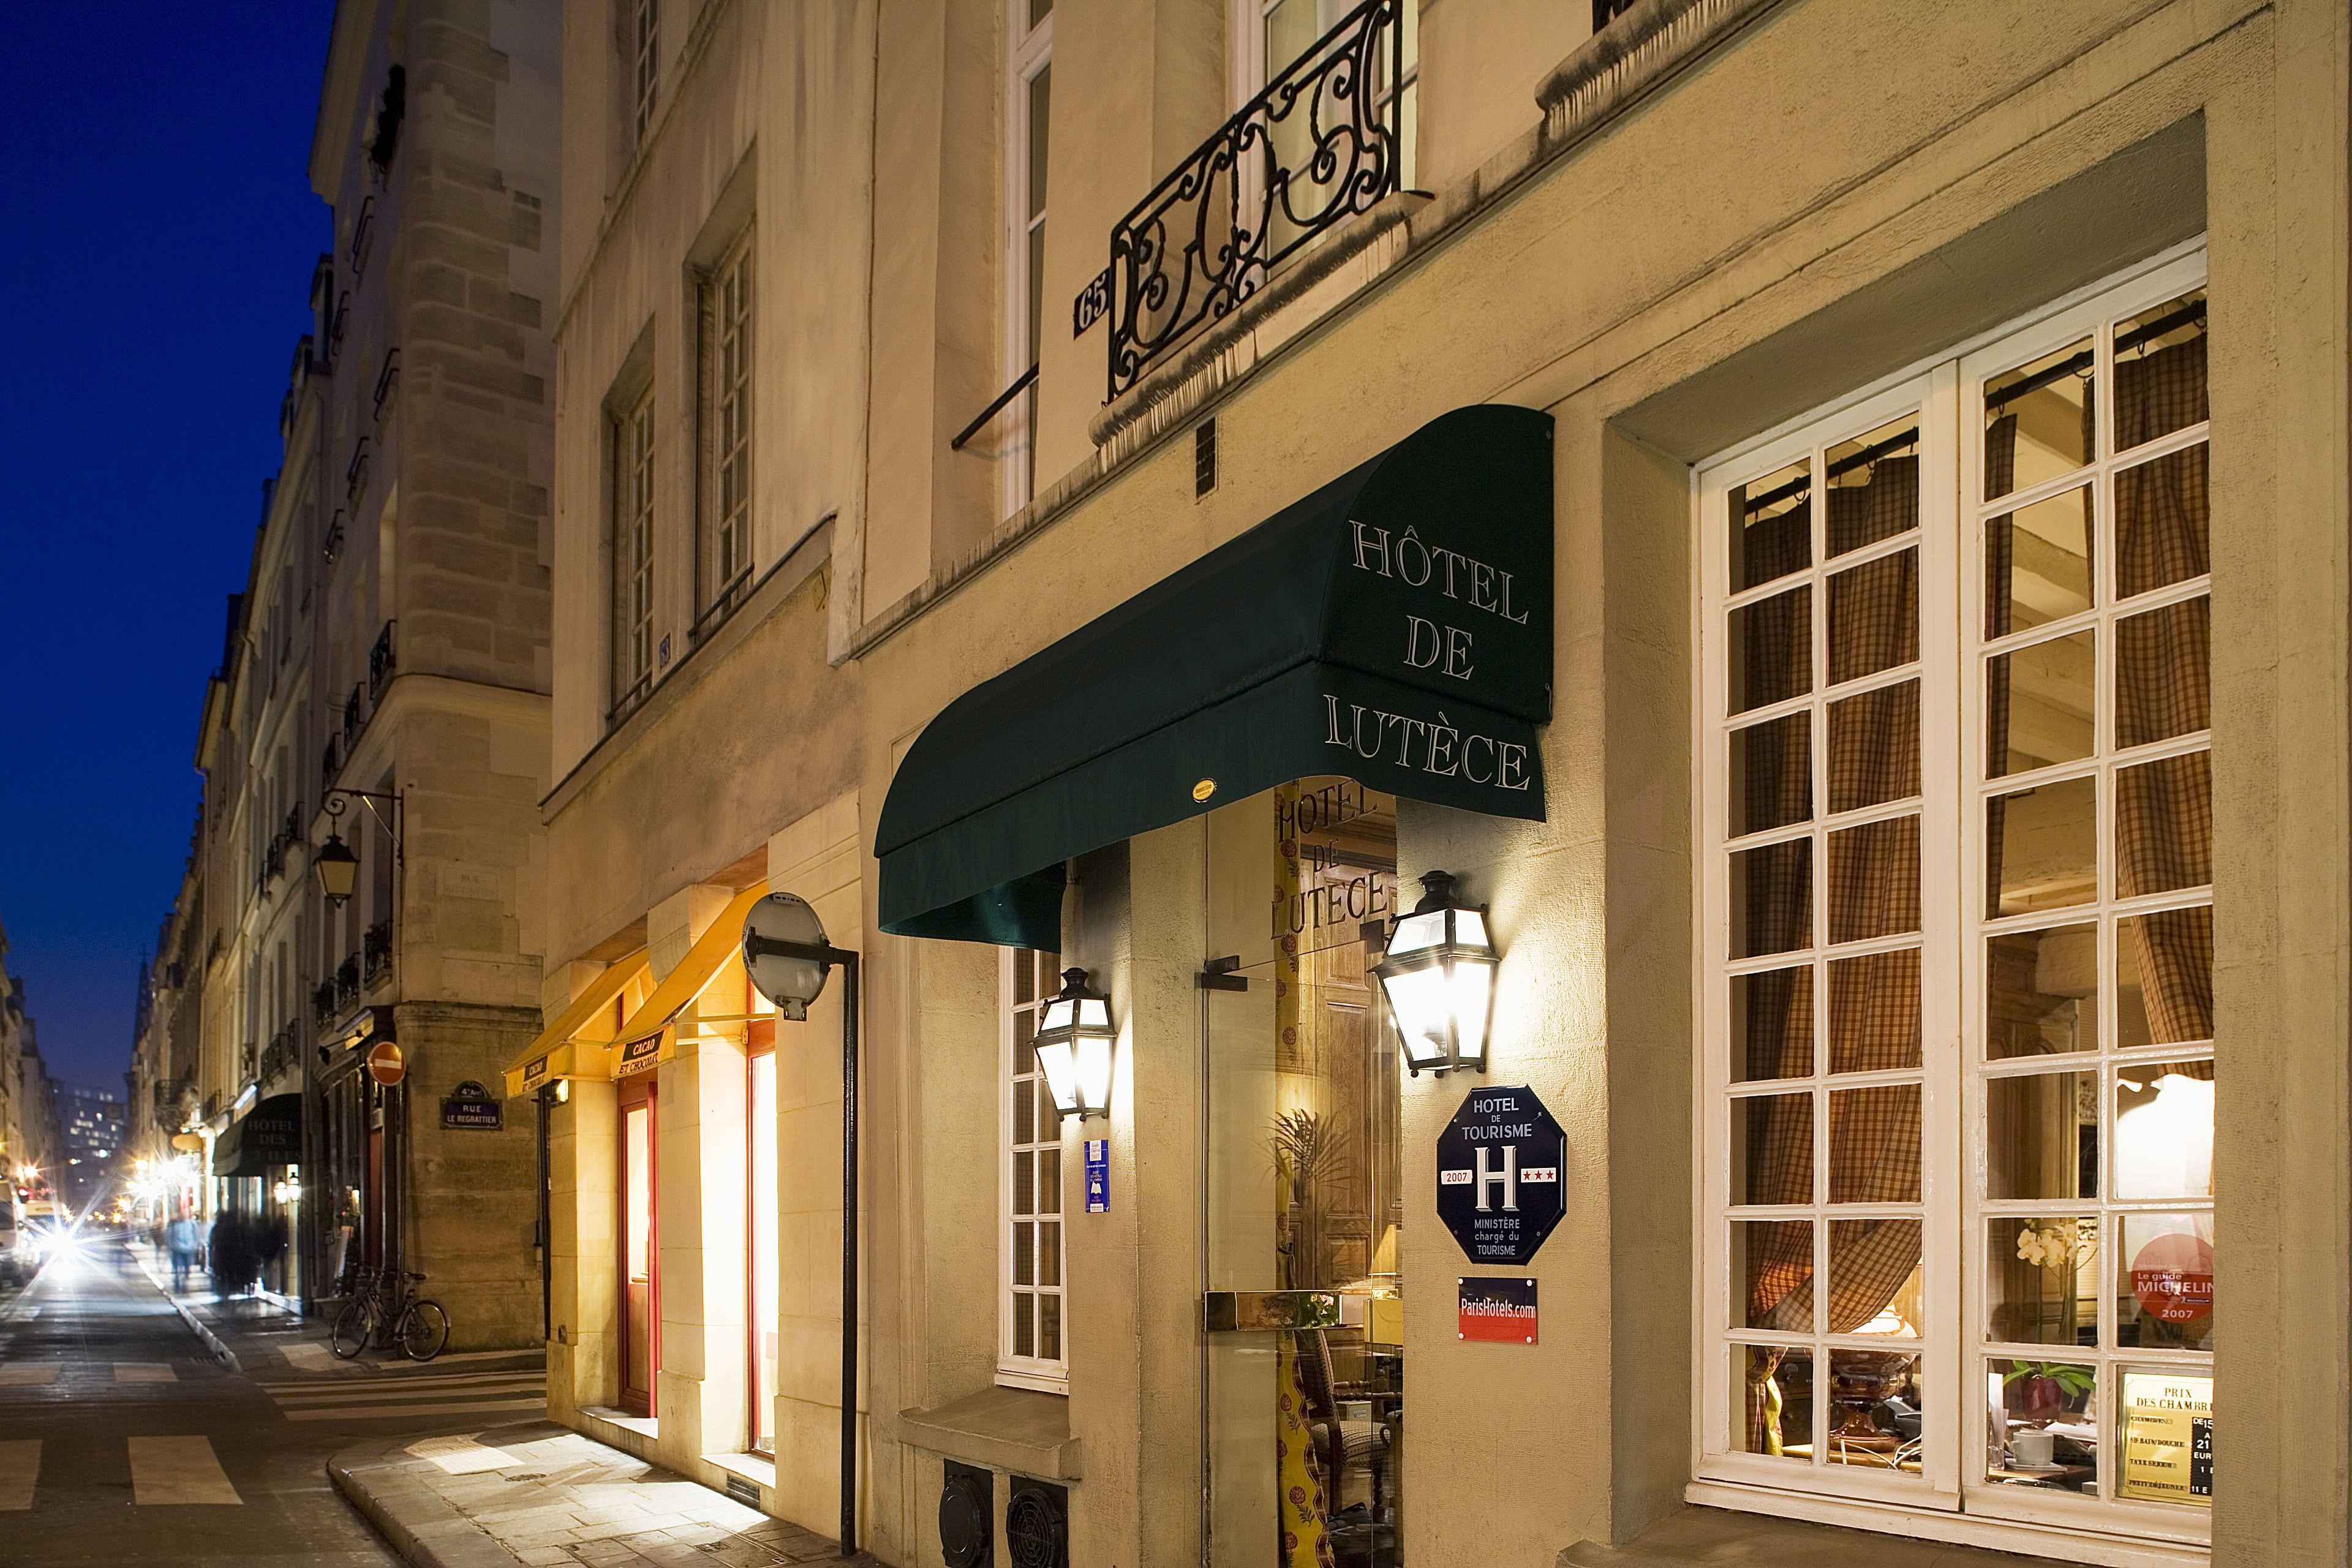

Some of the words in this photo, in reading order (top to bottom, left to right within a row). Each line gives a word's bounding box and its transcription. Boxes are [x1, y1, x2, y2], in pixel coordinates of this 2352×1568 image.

[1079, 273, 1106, 330] 65
[1349, 520, 1529, 625] HÔTEL
[1403, 615, 1474, 680] DE
[1323, 694, 1531, 791] LUTÈCE
[1314, 838, 1341, 872] DE
[1272, 867, 1387, 940] LUTECE
[633, 1038, 655, 1055] CACAO
[619, 1063, 629, 1074] ET
[630, 1052, 658, 1072] CHOCOLAT
[1474, 1097, 1519, 1114] HOTEL
[457, 1115, 496, 1124] REGRATTIER
[1461, 1123, 1532, 1140] TOURISME
[1447, 1172, 1468, 1182] 2007
[1474, 1145, 1520, 1212] H
[1474, 1217, 1520, 1229] MINISTÈRE
[1475, 1231, 1504, 1243] chargé
[1509, 1231, 1519, 1240] du
[1477, 1245, 1515, 1255] TOURISME
[2152, 1272, 2182, 1281] guide
[1461, 1298, 1536, 1318] ParisHotels.com
[2162, 1310, 2193, 1318] 2007
[2165, 1388, 2192, 1398] PRIX
[2136, 1397, 2156, 1408] DES
